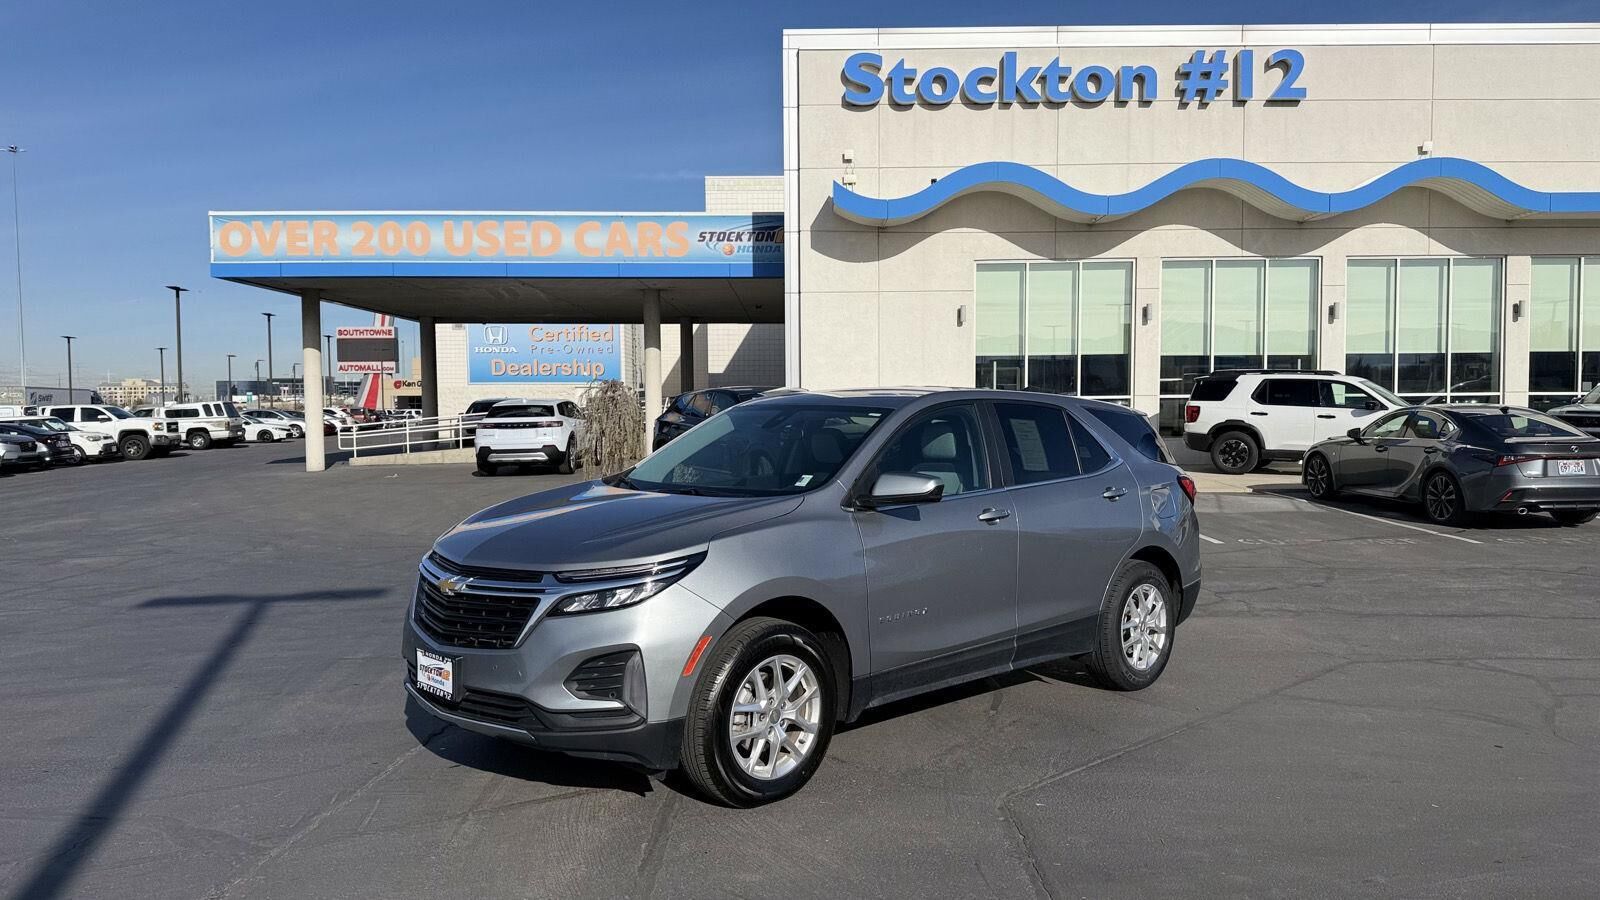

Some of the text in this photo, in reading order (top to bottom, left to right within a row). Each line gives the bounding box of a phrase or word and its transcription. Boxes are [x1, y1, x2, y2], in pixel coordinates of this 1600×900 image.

[842, 49, 1307, 108] Stockton #12
[219, 220, 690, 257] OVER 200 USED CARS
[697, 231, 776, 242] STOCKTON
[736, 245, 782, 254] HONDA
[337, 329, 393, 337] SOUTHTOWNE
[528, 325, 614, 342] Certified
[529, 344, 614, 355] Pre-Owned
[491, 358, 605, 378] Dealership
[425, 652, 443, 661] HONDA
[419, 664, 443, 676] STOCKTON
